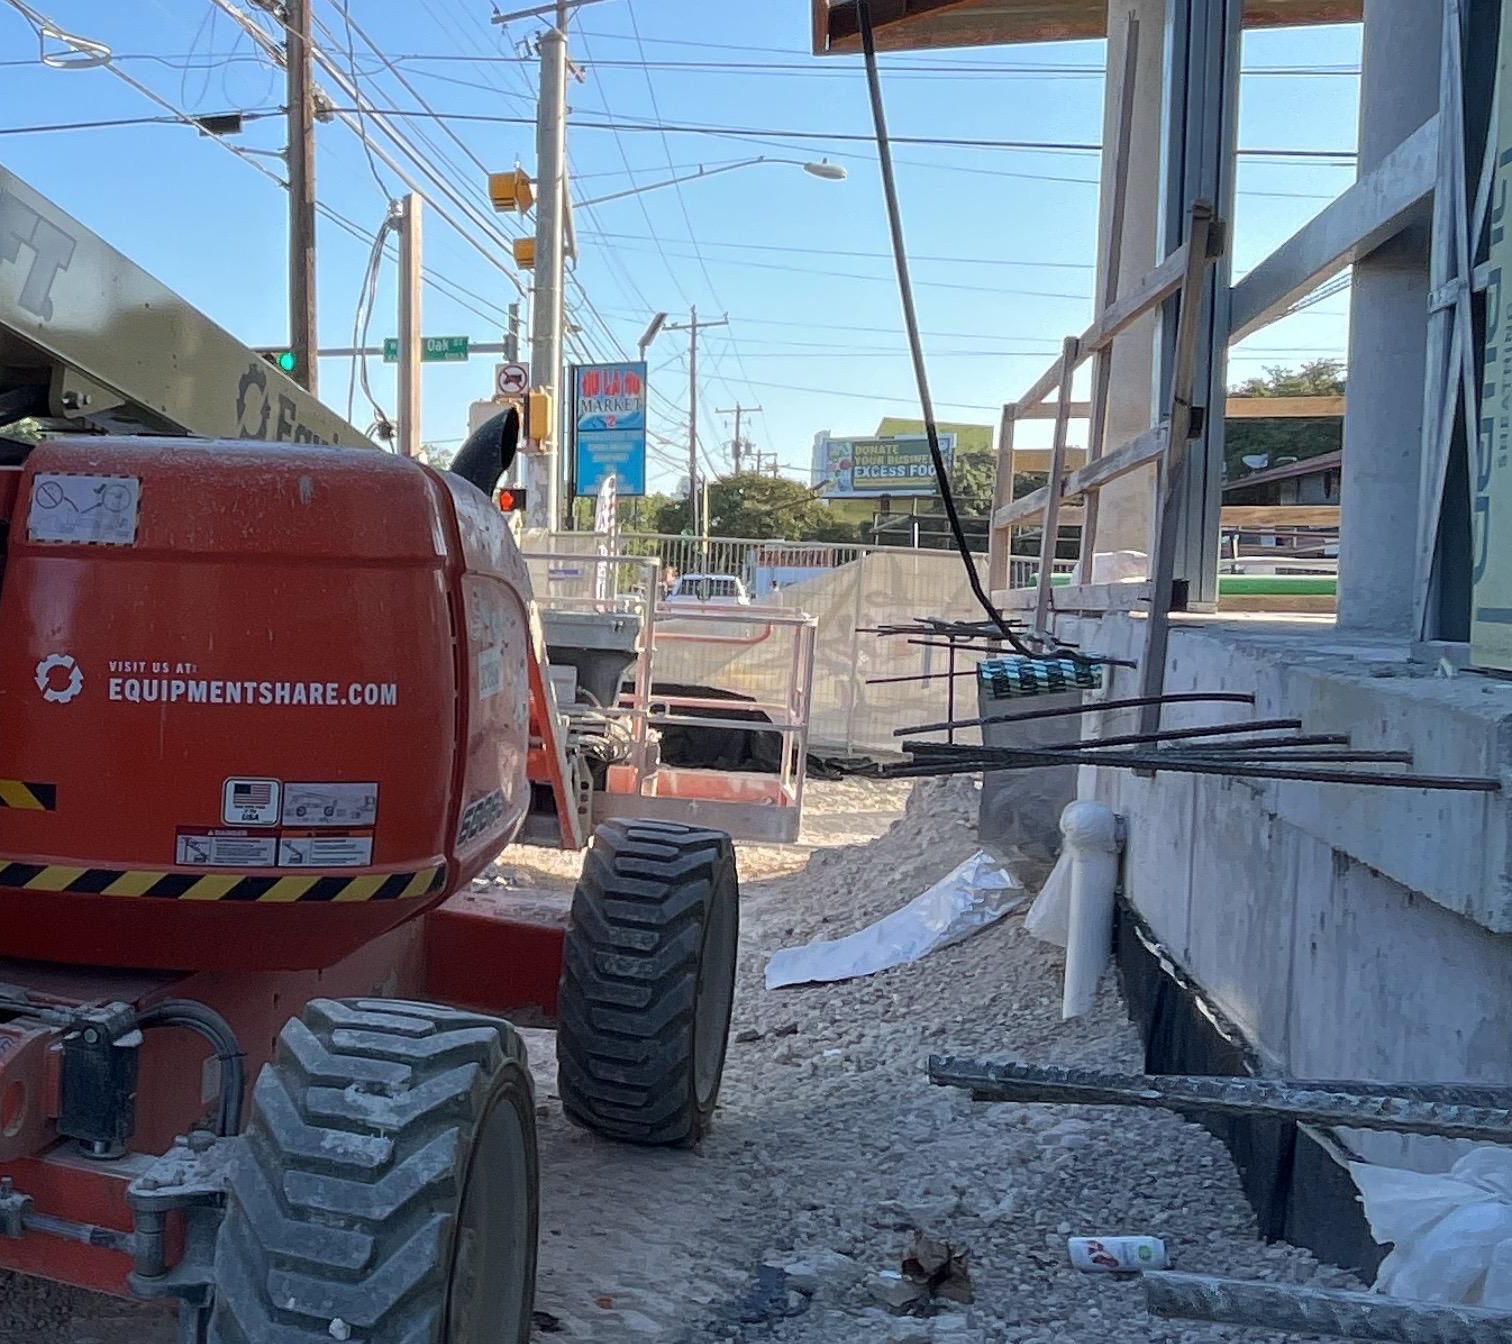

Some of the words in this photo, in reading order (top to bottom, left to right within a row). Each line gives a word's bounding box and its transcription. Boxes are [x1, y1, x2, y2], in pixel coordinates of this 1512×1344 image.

[428, 338, 449, 352] Oak
[581, 396, 643, 413] MARKET
[855, 444, 900, 455] DONATE
[854, 465, 906, 477] EXCESS
[109, 660, 147, 673] VISIT
[152, 661, 170, 673] US
[108, 678, 398, 706] EQUIPMENTSHARE.COM
